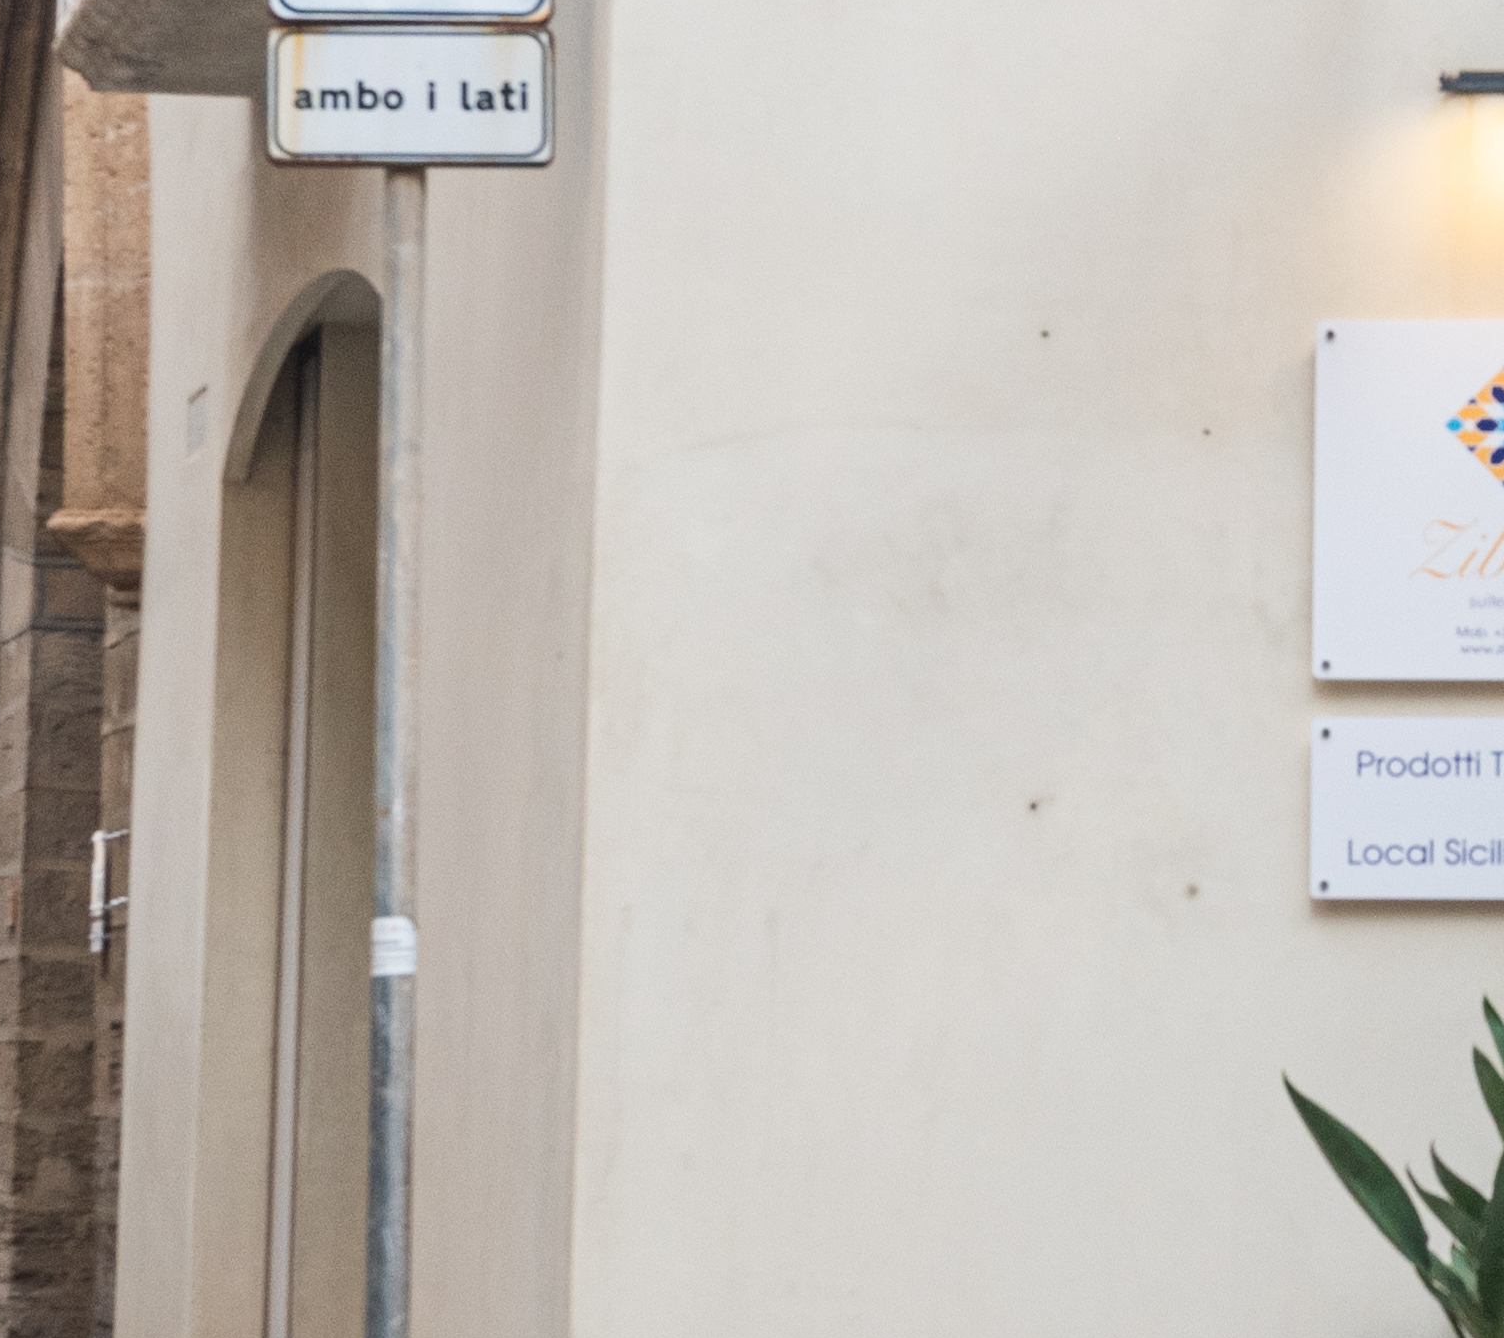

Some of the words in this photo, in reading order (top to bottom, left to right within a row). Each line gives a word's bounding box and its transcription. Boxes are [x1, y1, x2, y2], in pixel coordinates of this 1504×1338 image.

[292, 80, 404, 112] ambo
[427, 80, 437, 112] i
[460, 80, 529, 112] lati
[1356, 749, 1482, 779] Prodotti
[1346, 838, 1435, 867] Local
